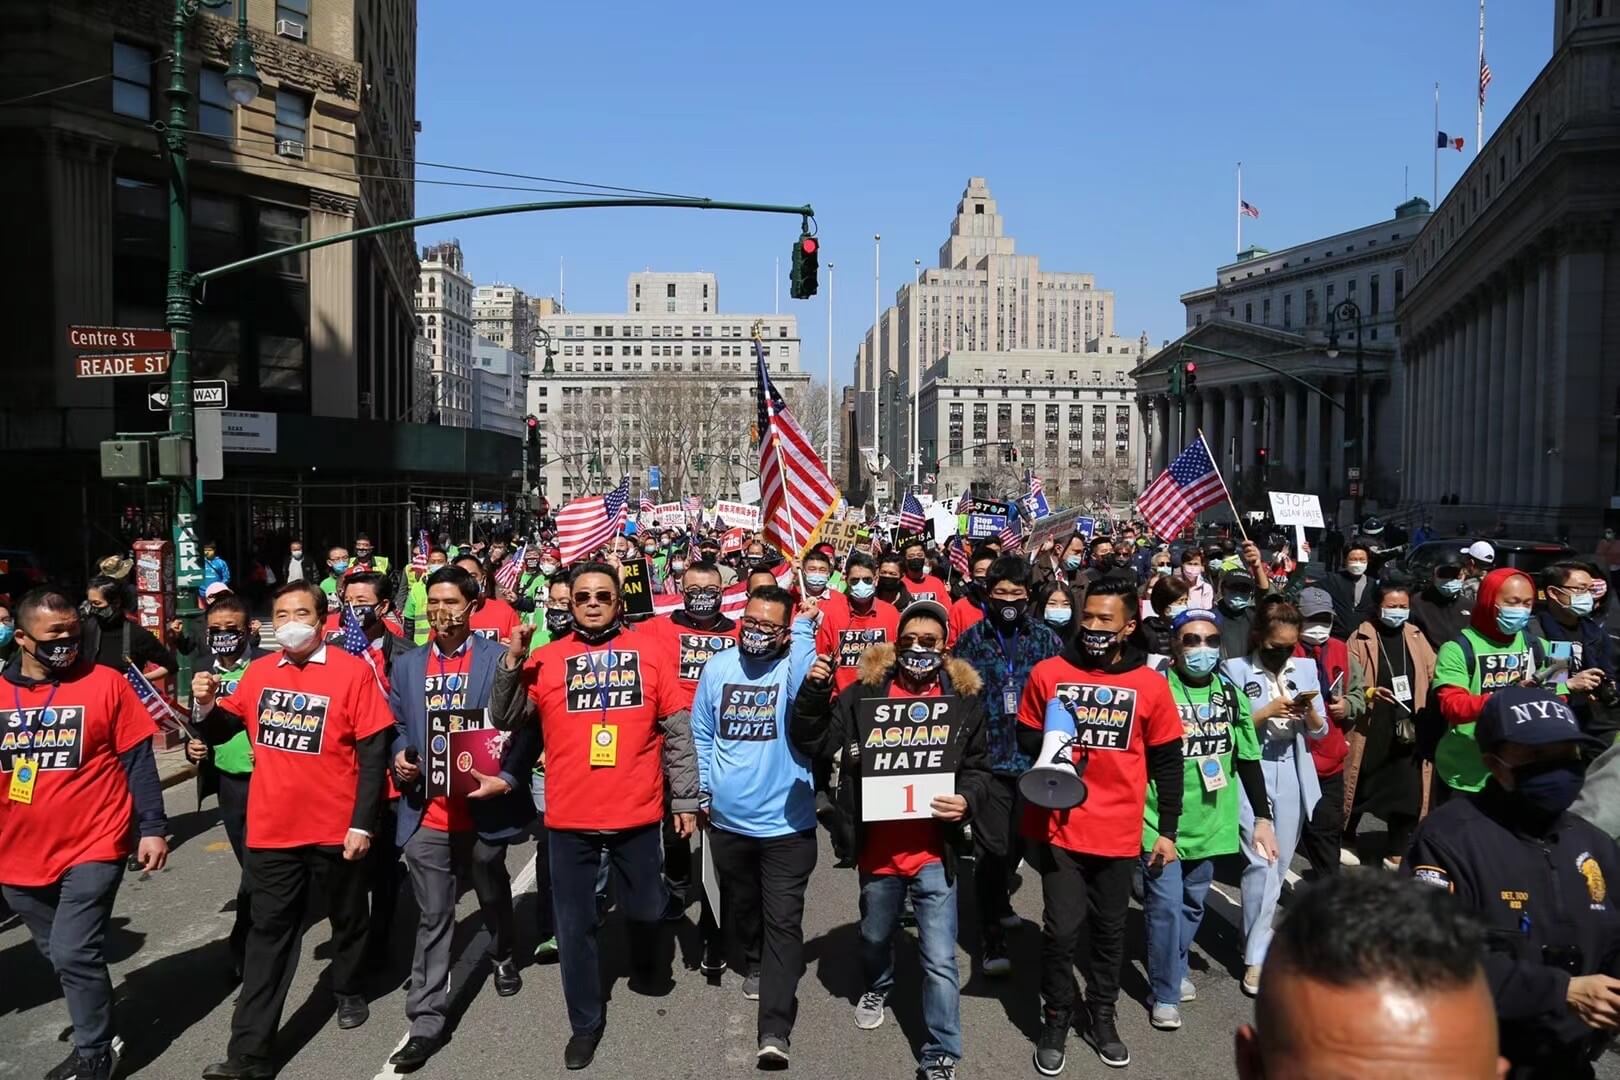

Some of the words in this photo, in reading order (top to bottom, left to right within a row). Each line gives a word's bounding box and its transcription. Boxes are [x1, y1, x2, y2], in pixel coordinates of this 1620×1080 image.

[71, 330, 117, 346] Centre
[122, 332, 136, 347] St
[80, 358, 136, 375] READE
[145, 356, 165, 373] ST
[194, 389, 220, 400] WAY
[975, 502, 1006, 514] STOP
[1275, 493, 1311, 507] STOP
[1280, 508, 1301, 516] ASIAN
[1302, 509, 1321, 519] HATE
[844, 523, 857, 538] IS
[177, 513, 201, 571] PARK
[689, 636, 734, 650] STOP
[845, 629, 882, 642] STOP
[576, 652, 633, 672] STOP
[569, 670, 636, 691] ASIAN
[269, 691, 322, 712] STOP
[425, 693, 467, 711] SIA
[576, 690, 633, 709] HATE
[729, 690, 777, 706] STOP
[1067, 685, 1130, 706] STOP
[8, 707, 77, 728] STOP
[259, 709, 320, 732] ASIAN
[722, 704, 776, 722] ASIAN
[874, 701, 949, 723] STOP
[0, 728, 77, 750] ASIAN
[727, 722, 774, 737] HATE
[865, 725, 950, 748] ASIAN
[1081, 729, 1120, 746] ATE
[263, 730, 312, 750] HATE
[11, 751, 70, 768] TE
[431, 716, 447, 786] STOP
[873, 750, 944, 770] HATE
[902, 783, 917, 813] 1
